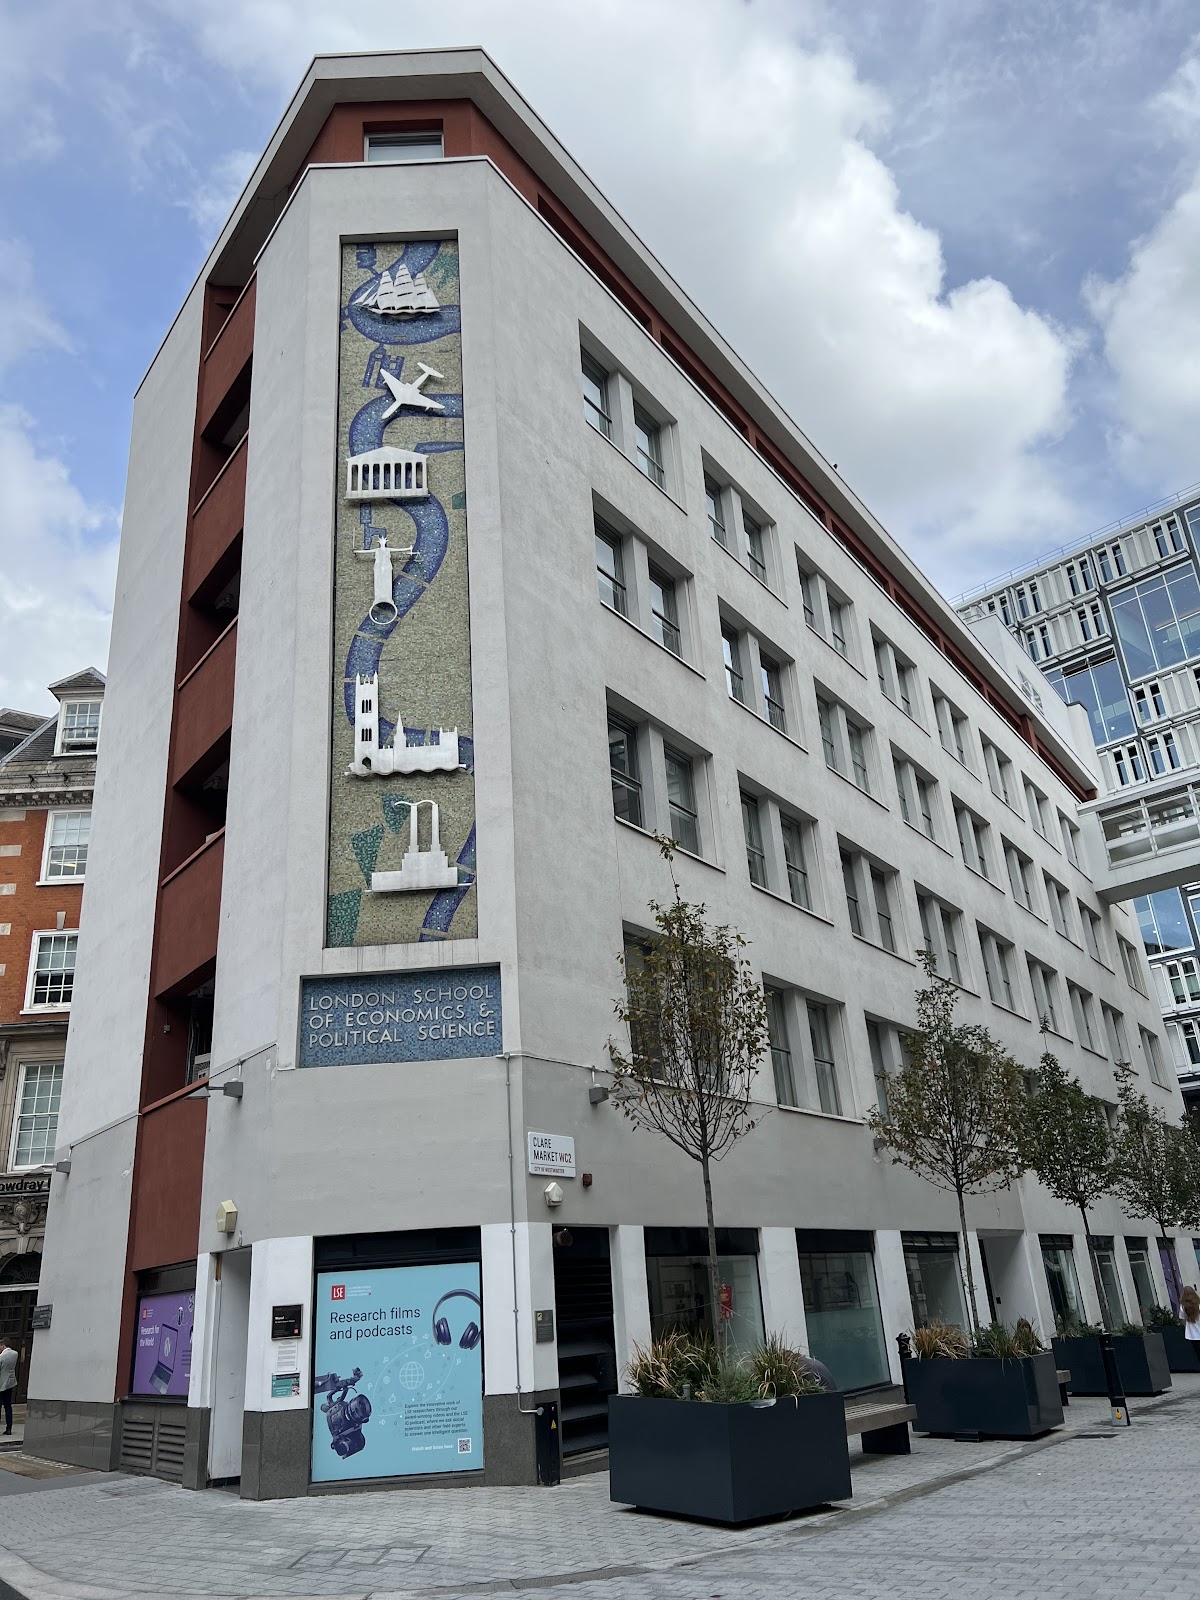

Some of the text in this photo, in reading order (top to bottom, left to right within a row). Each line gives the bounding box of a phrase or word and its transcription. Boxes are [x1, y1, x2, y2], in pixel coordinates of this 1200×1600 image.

[310, 984, 494, 1011] LONDON SCHOOL
[309, 1003, 495, 1029] OF ECONOMICS &
[309, 1021, 495, 1048] POLITICAL SCIENCE
[533, 1137, 551, 1148] CLARE
[533, 1150, 572, 1163] MARKET WC2
[333, 1287, 344, 1298] LSE
[330, 1306, 421, 1324] Research films
[329, 1324, 413, 1341] and podcasts
